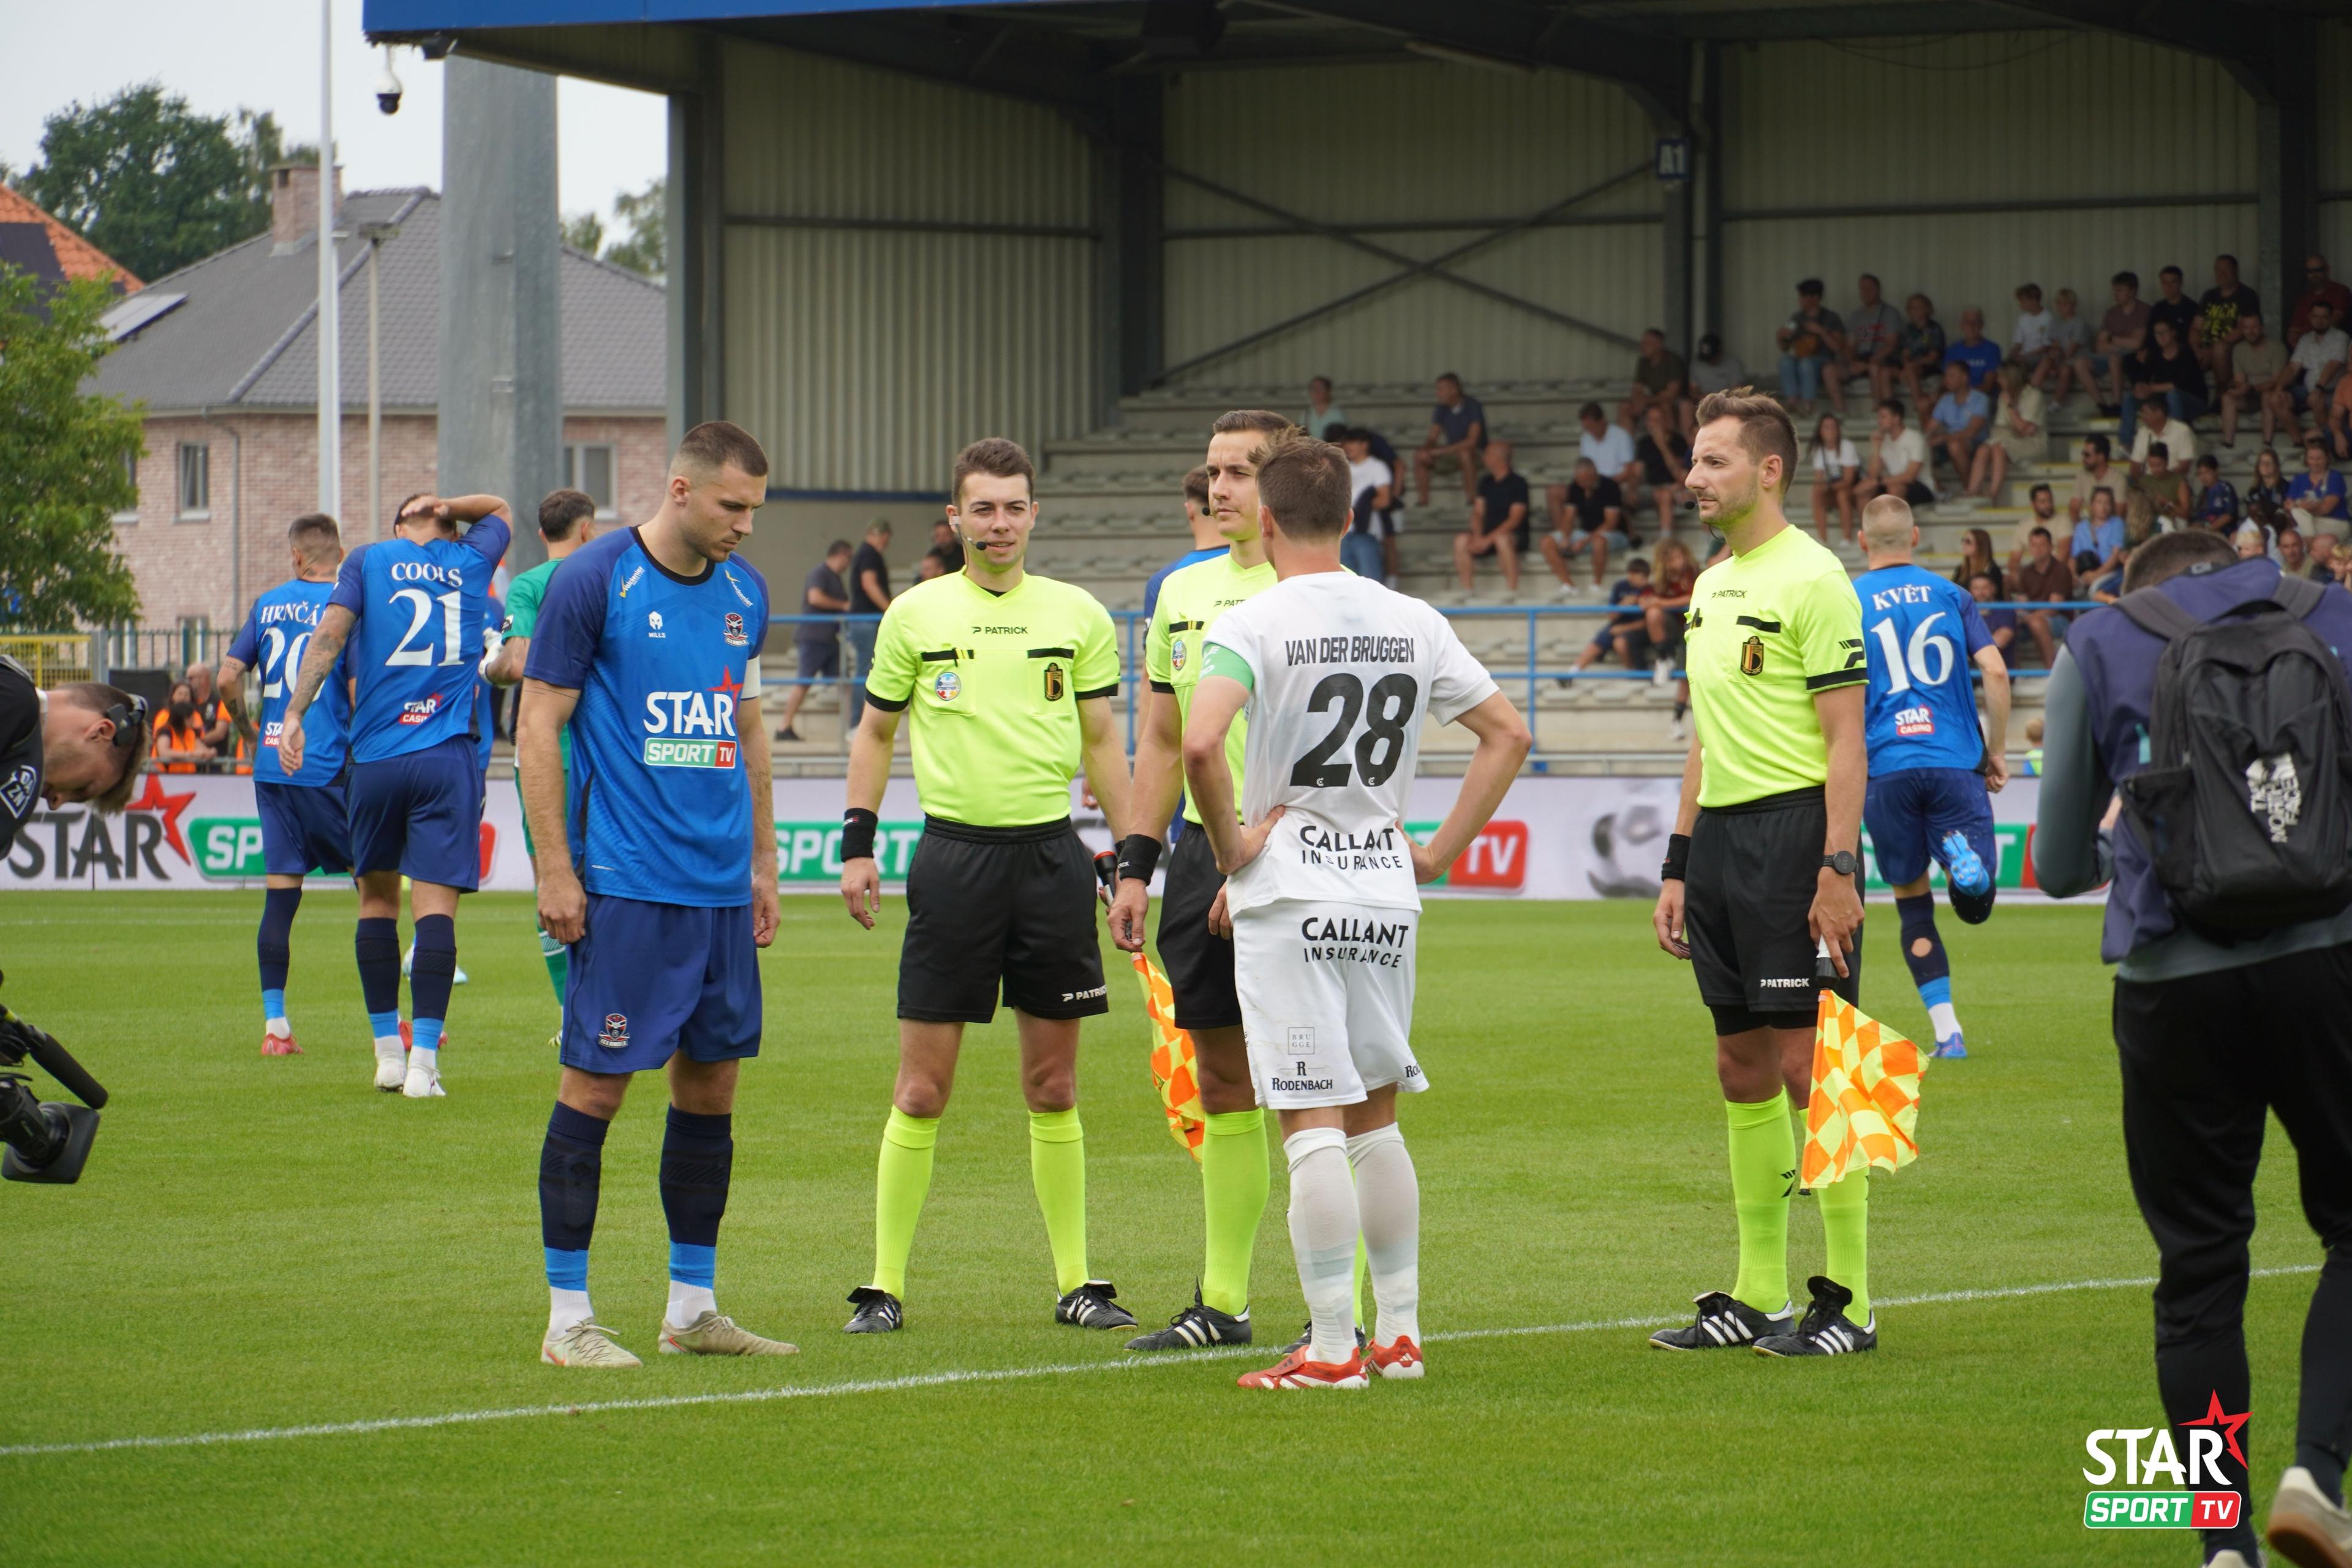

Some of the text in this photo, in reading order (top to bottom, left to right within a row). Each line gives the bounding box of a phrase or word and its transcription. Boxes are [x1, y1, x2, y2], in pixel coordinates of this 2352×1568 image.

[391, 562, 463, 587] COOLS
[1717, 590, 1747, 599] PATRICK
[1873, 584, 1932, 611] KVĚT
[260, 600, 326, 625] HRNČÁ
[385, 589, 464, 666] 21
[1286, 636, 1414, 666] VAN DER BRUGGEN
[1871, 611, 1954, 695] 16
[643, 690, 736, 737] STAR
[1895, 707, 1931, 726] STAR
[265, 722, 284, 736] STA
[1289, 673, 1418, 788] 28
[1900, 723, 1932, 734] CASINO
[647, 742, 734, 763] SPORT TV
[7, 810, 172, 880] STAR
[1466, 835, 1518, 876] TV
[1302, 917, 1409, 948] CALLANT
[1304, 947, 1402, 968] INSURANCE
[1766, 978, 1810, 988] PATRICK
